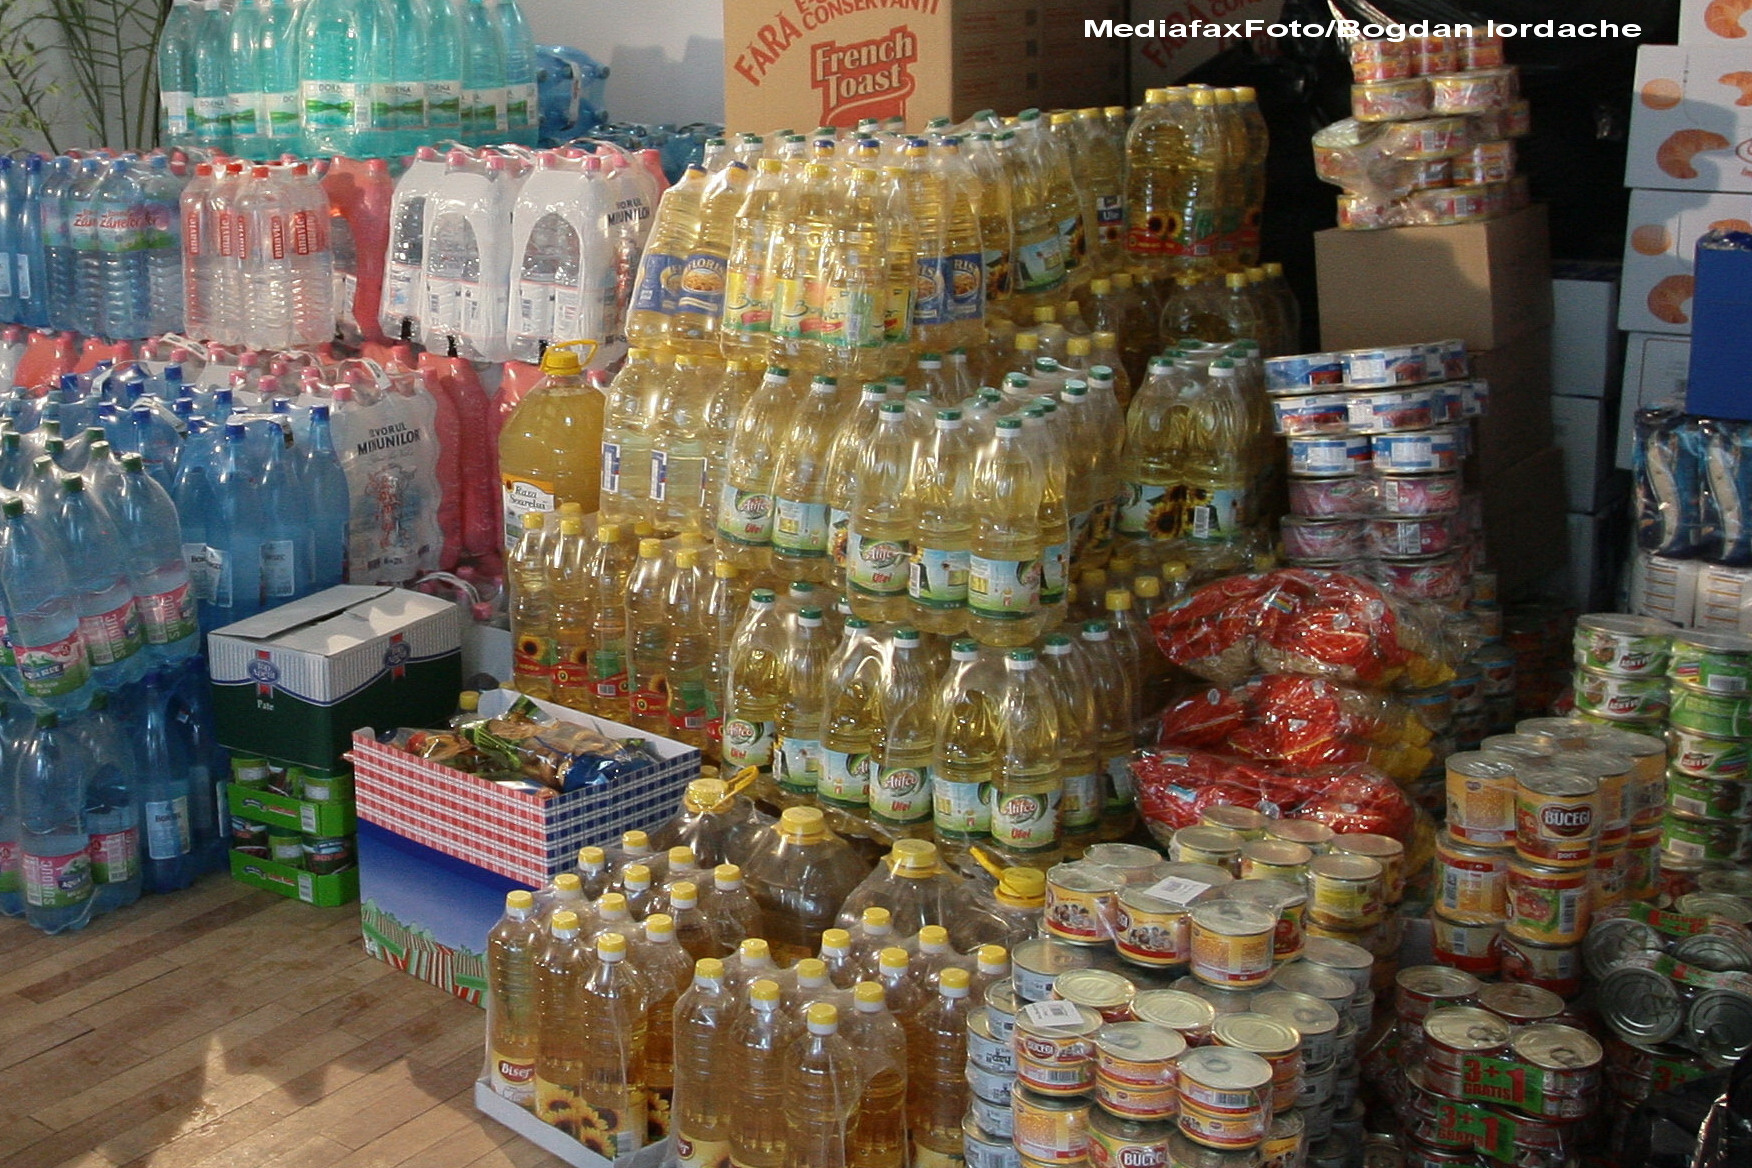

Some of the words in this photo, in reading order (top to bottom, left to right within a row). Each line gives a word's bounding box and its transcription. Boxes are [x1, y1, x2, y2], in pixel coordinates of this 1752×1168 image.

[815, 31, 913, 81] French
[823, 64, 902, 108] Toast
[514, 485, 538, 499] Raza
[1545, 809, 1590, 826] BUCEGI
